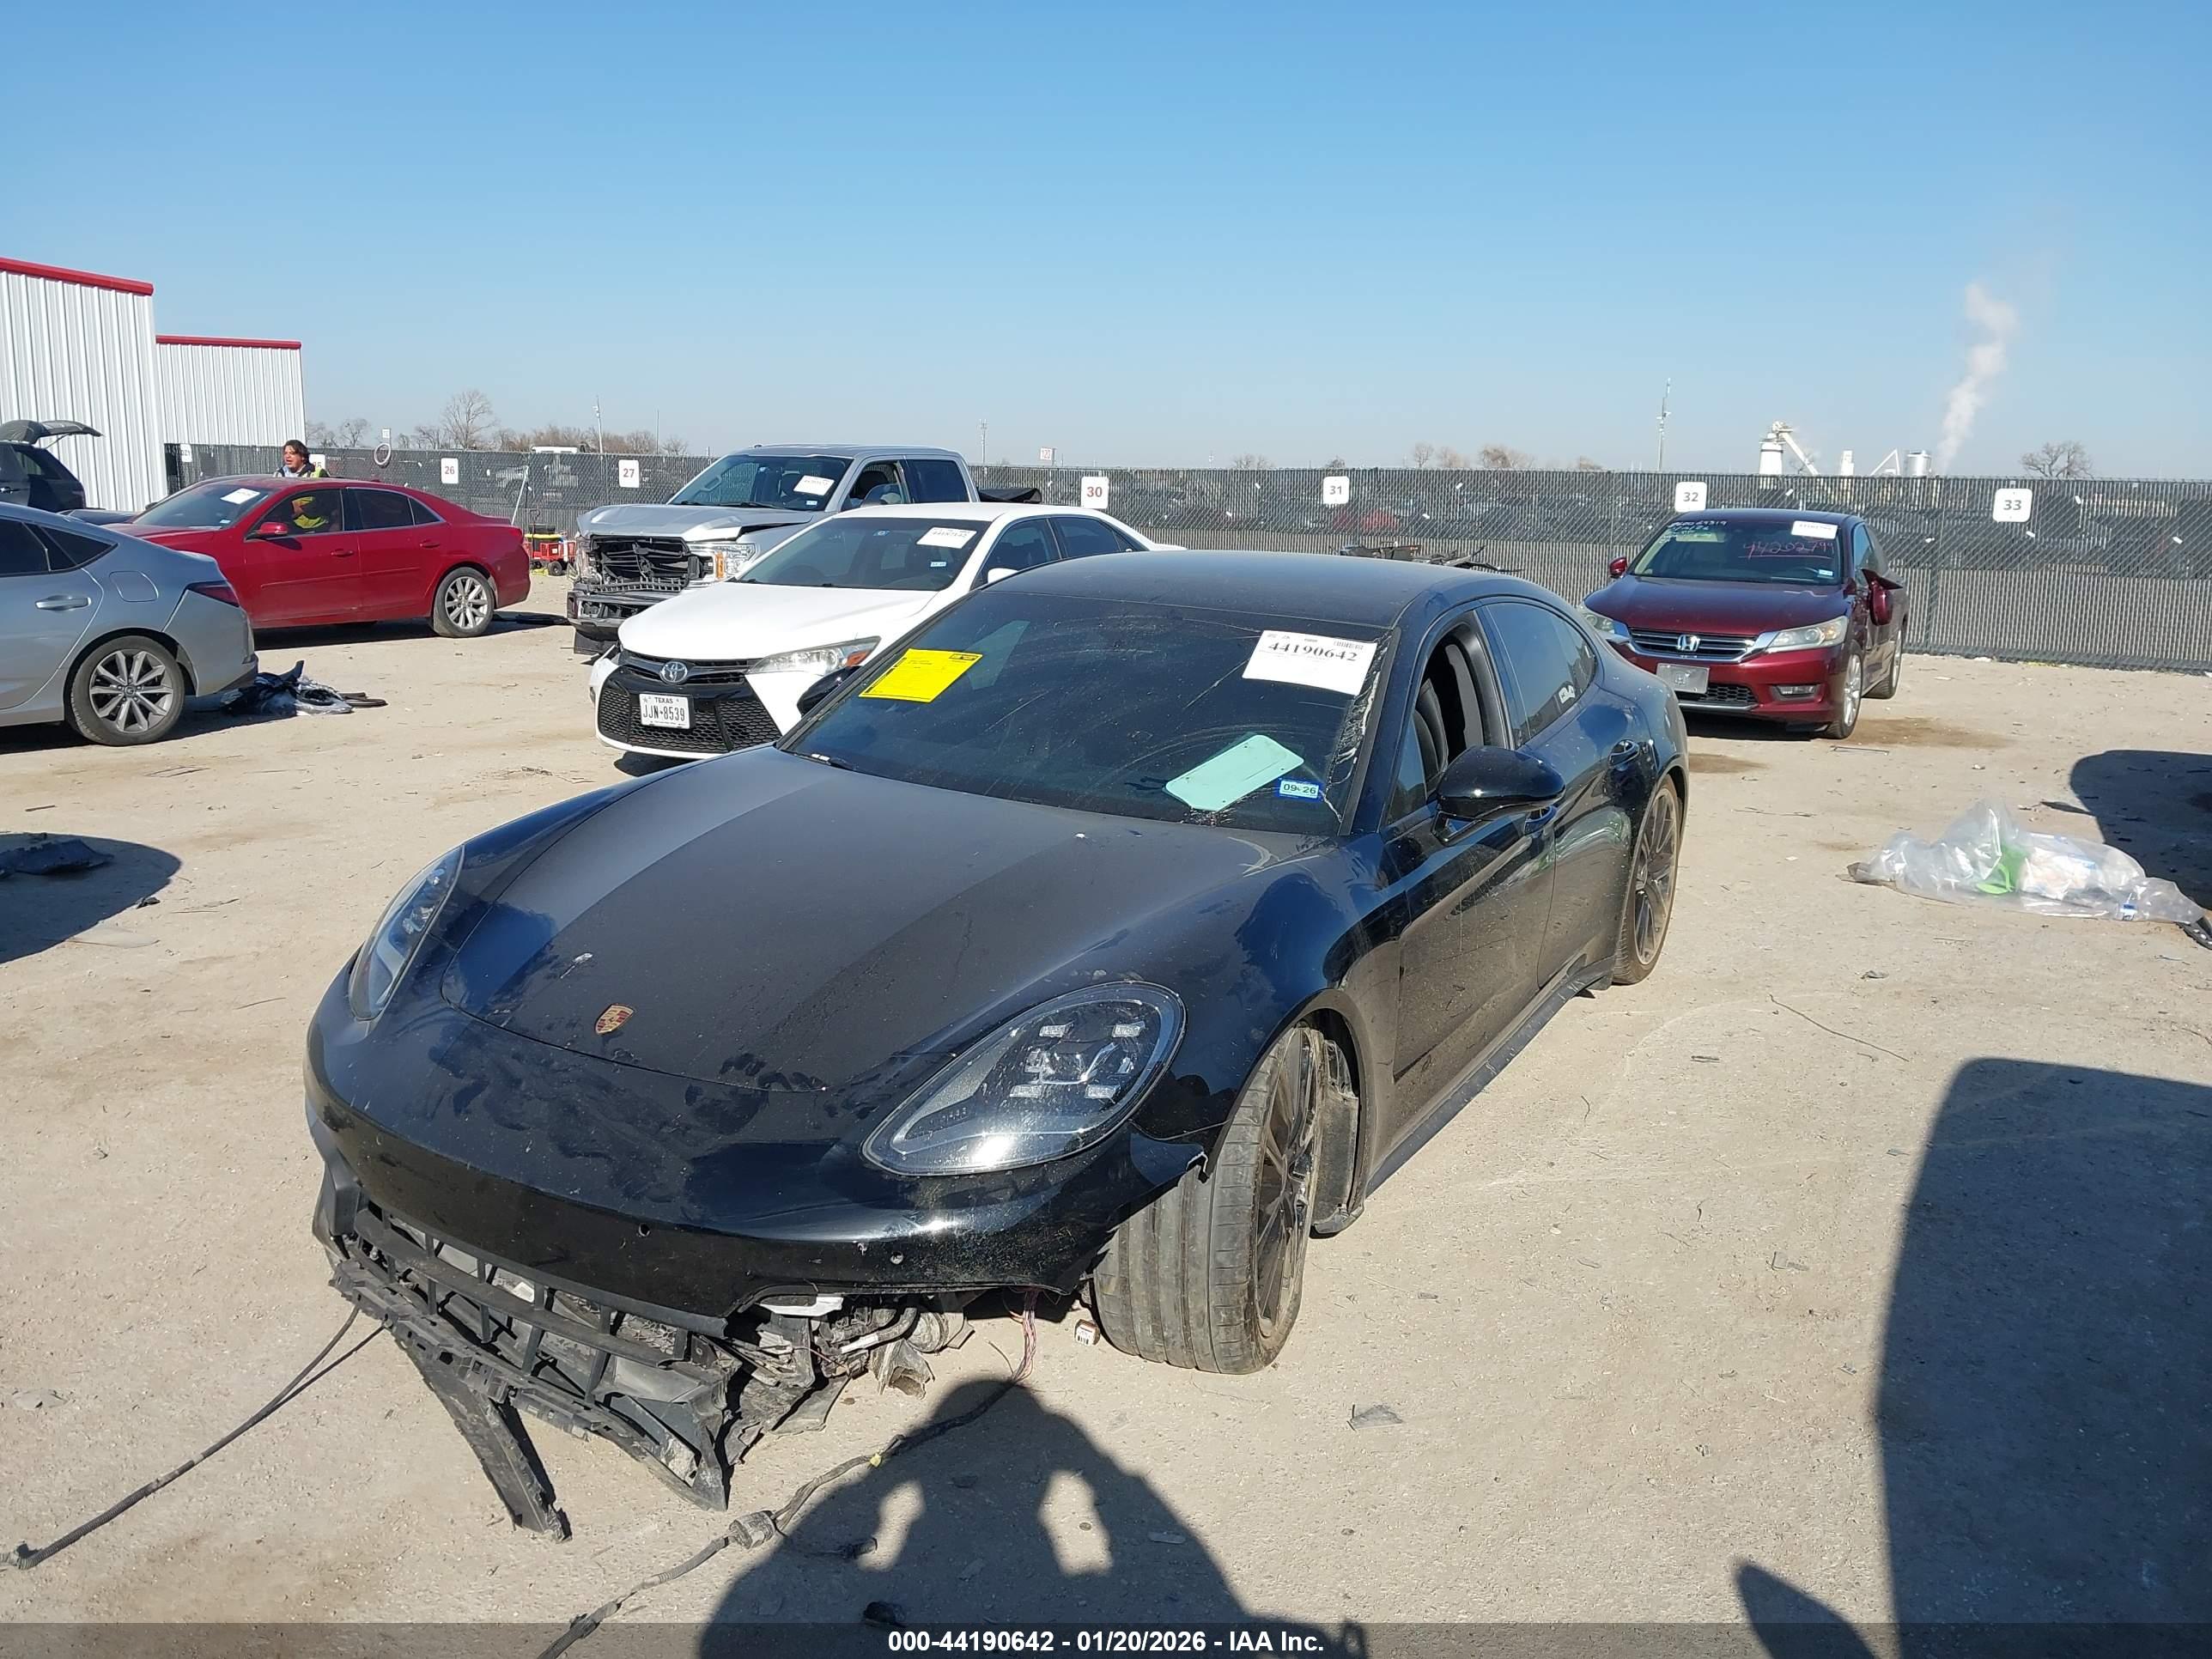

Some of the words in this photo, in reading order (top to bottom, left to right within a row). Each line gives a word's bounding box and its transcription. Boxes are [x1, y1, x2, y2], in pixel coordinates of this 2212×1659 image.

[444, 465, 455, 475] 26
[623, 468, 635, 478] 27
[1086, 486, 1103, 498] 30
[1329, 485, 1342, 495] 31
[1683, 492, 1698, 502] 32
[2003, 500, 2021, 511] 33
[1267, 642, 1358, 662] 44190642
